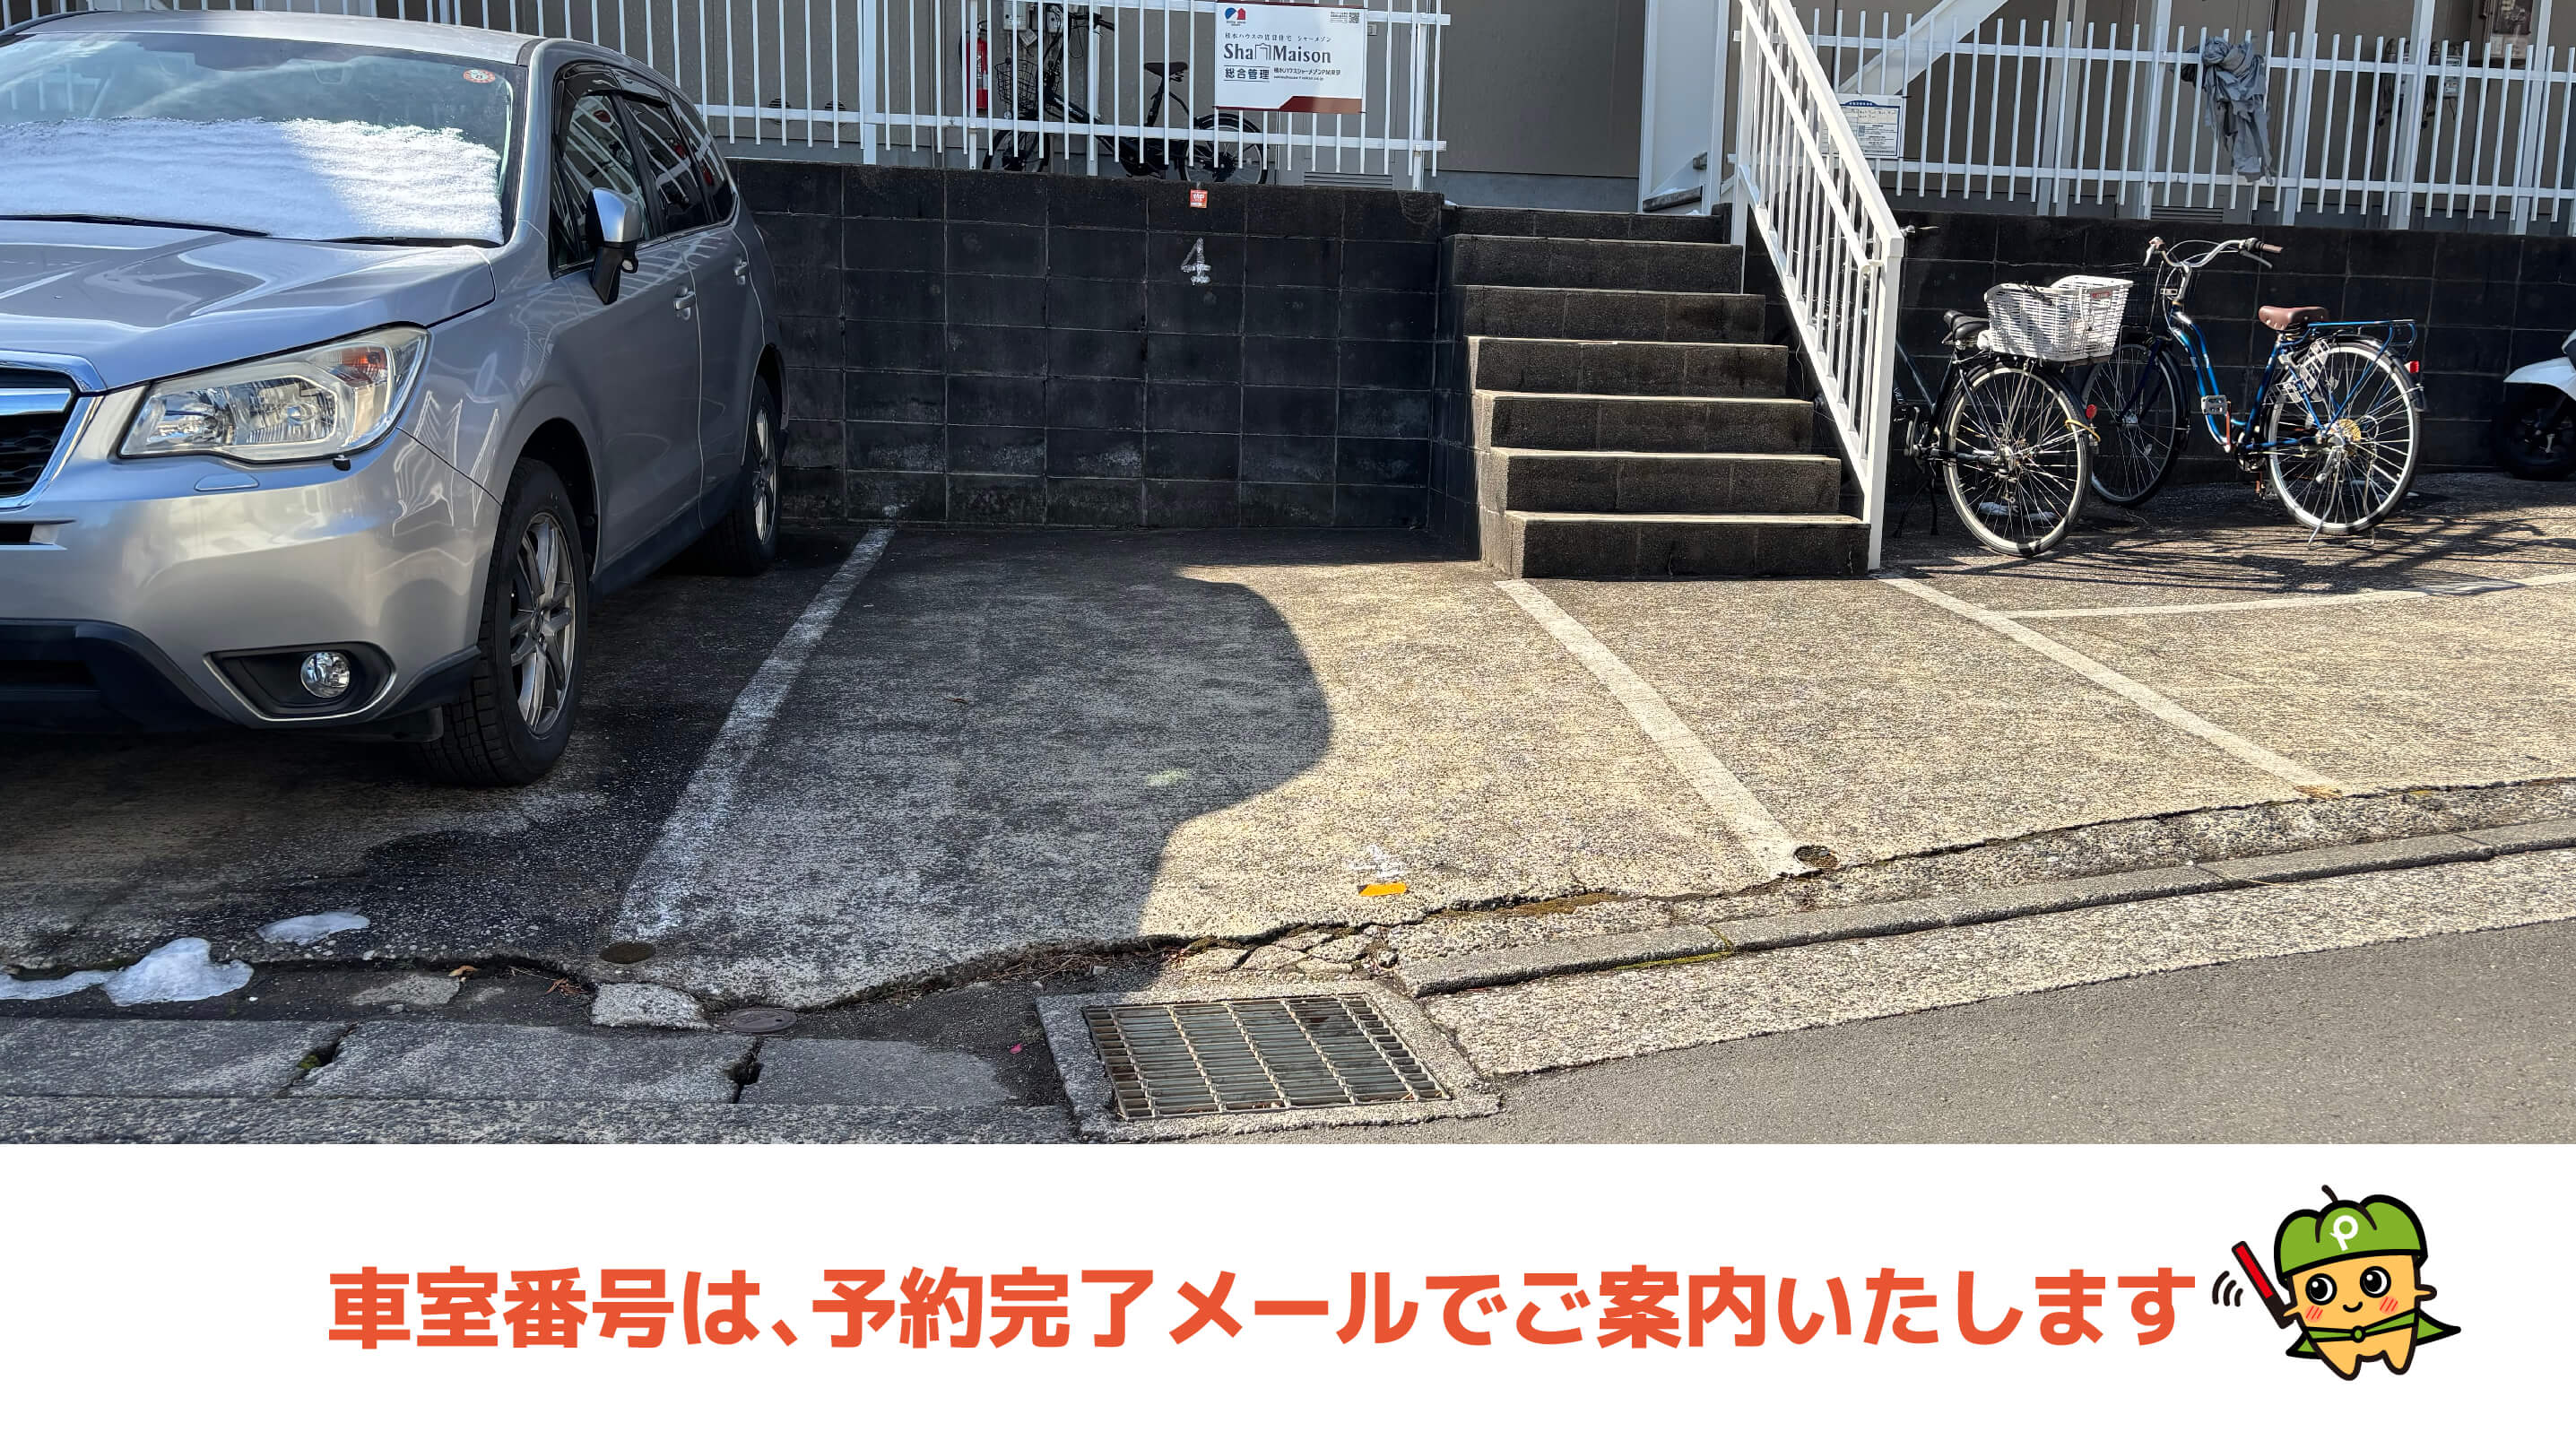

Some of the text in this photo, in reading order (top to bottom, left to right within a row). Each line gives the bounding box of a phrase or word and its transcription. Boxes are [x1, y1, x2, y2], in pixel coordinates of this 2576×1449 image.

[1223, 43, 1331, 64] Sha Maison
[1225, 67, 1270, 80] 総合管理
[1181, 238, 1211, 285] 4
